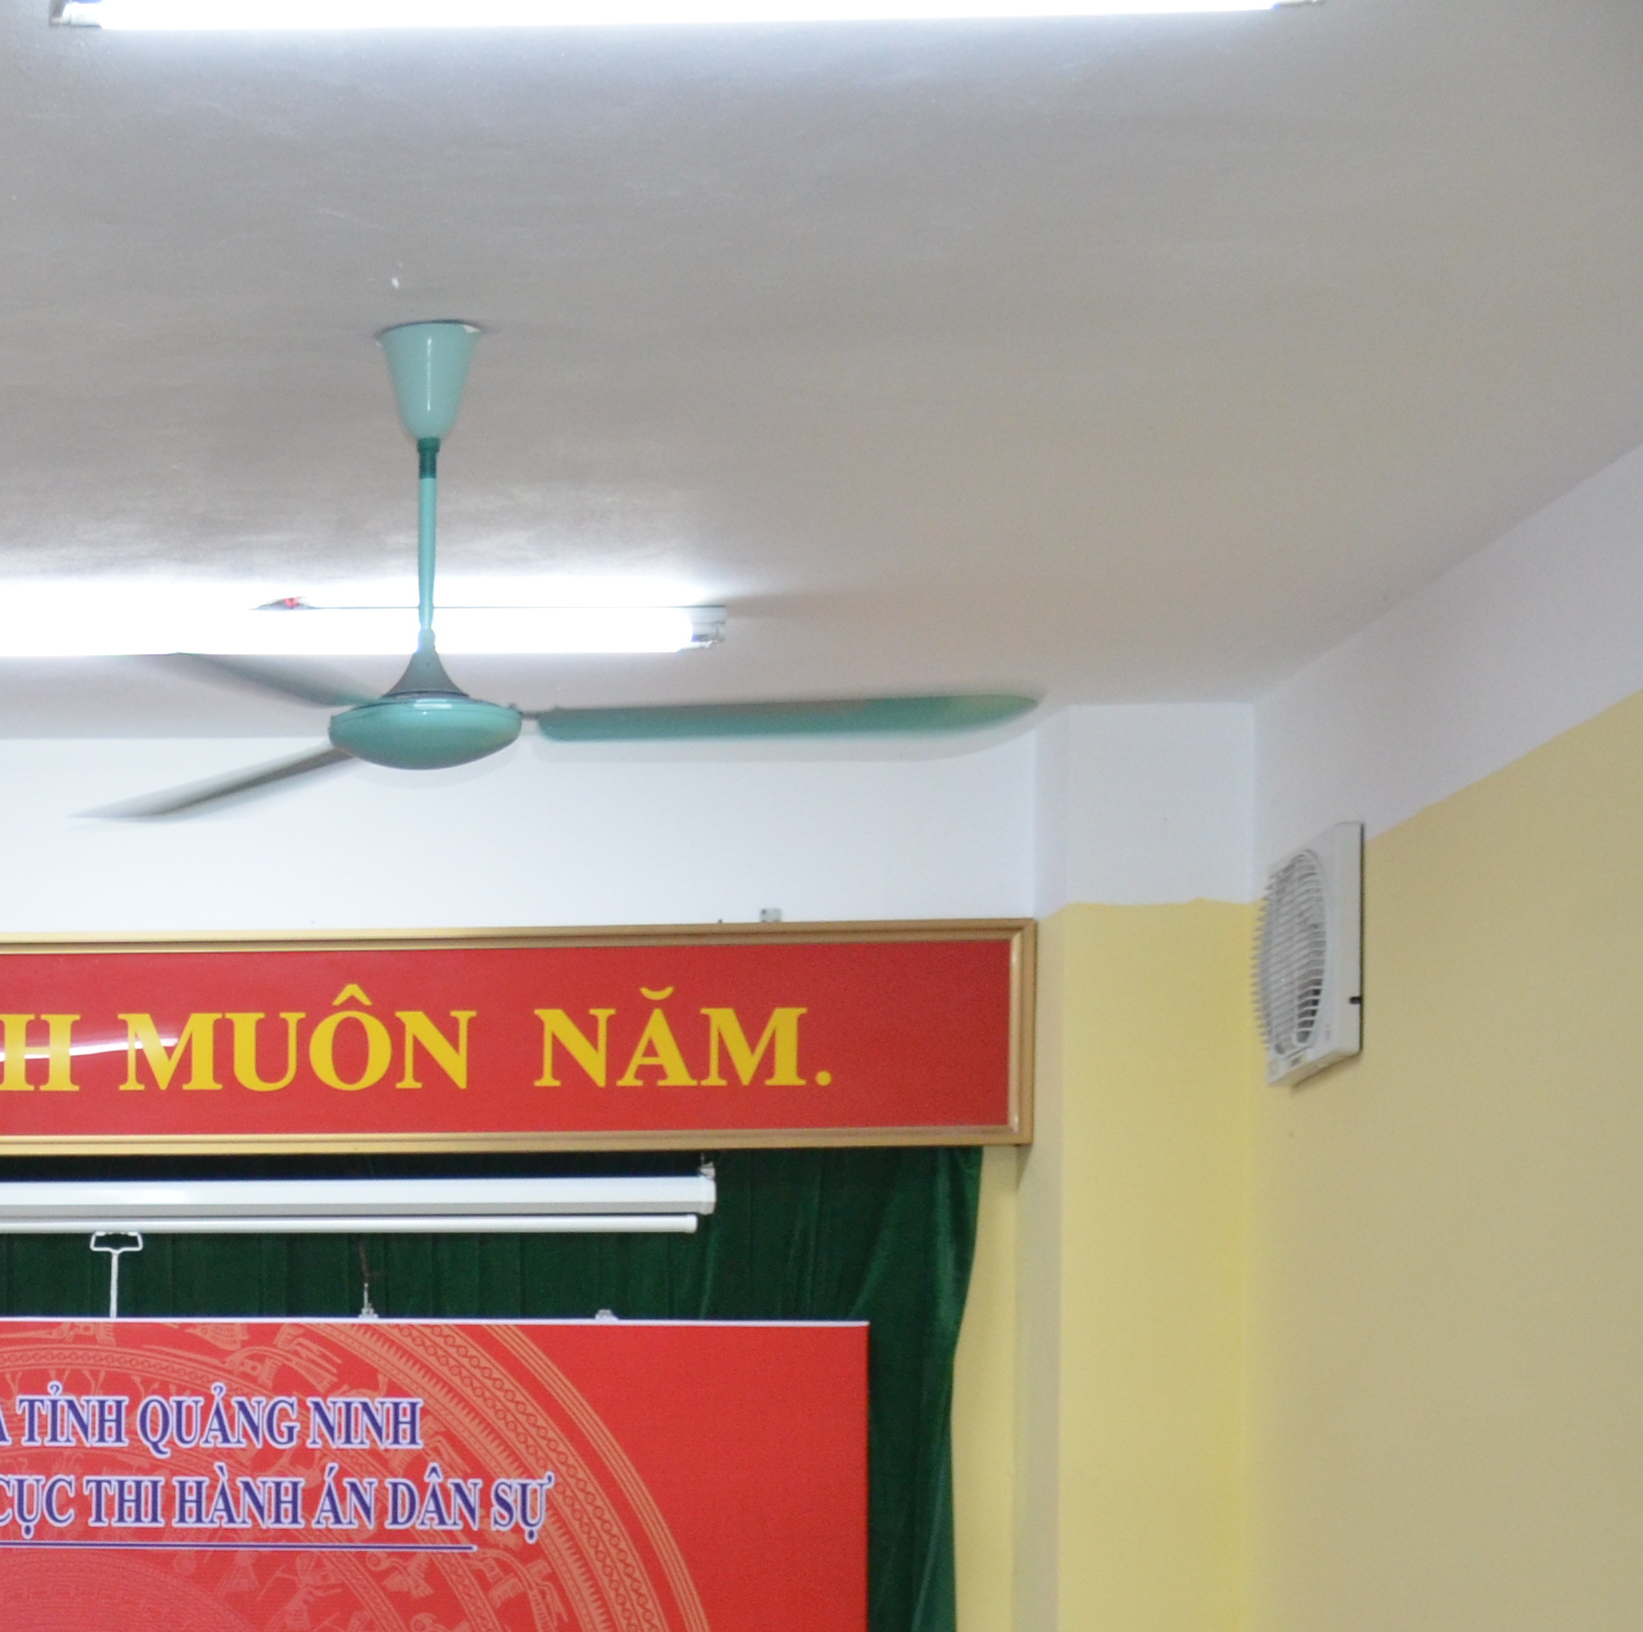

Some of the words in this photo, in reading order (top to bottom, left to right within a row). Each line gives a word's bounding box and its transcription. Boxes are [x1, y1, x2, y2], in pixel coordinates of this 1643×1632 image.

[118, 983, 476, 1092] MUÔN
[535, 986, 832, 1087] NĂM.
[17, 1381, 128, 1447] TỈNH
[137, 1384, 301, 1459] QUẢNG
[308, 1396, 424, 1450] NINH
[84, 1475, 165, 1527] THI
[172, 1462, 305, 1529] HÀNH
[313, 1462, 377, 1530] ÁN
[385, 1462, 482, 1531] DÂN
[490, 1470, 555, 1543] SỰ
